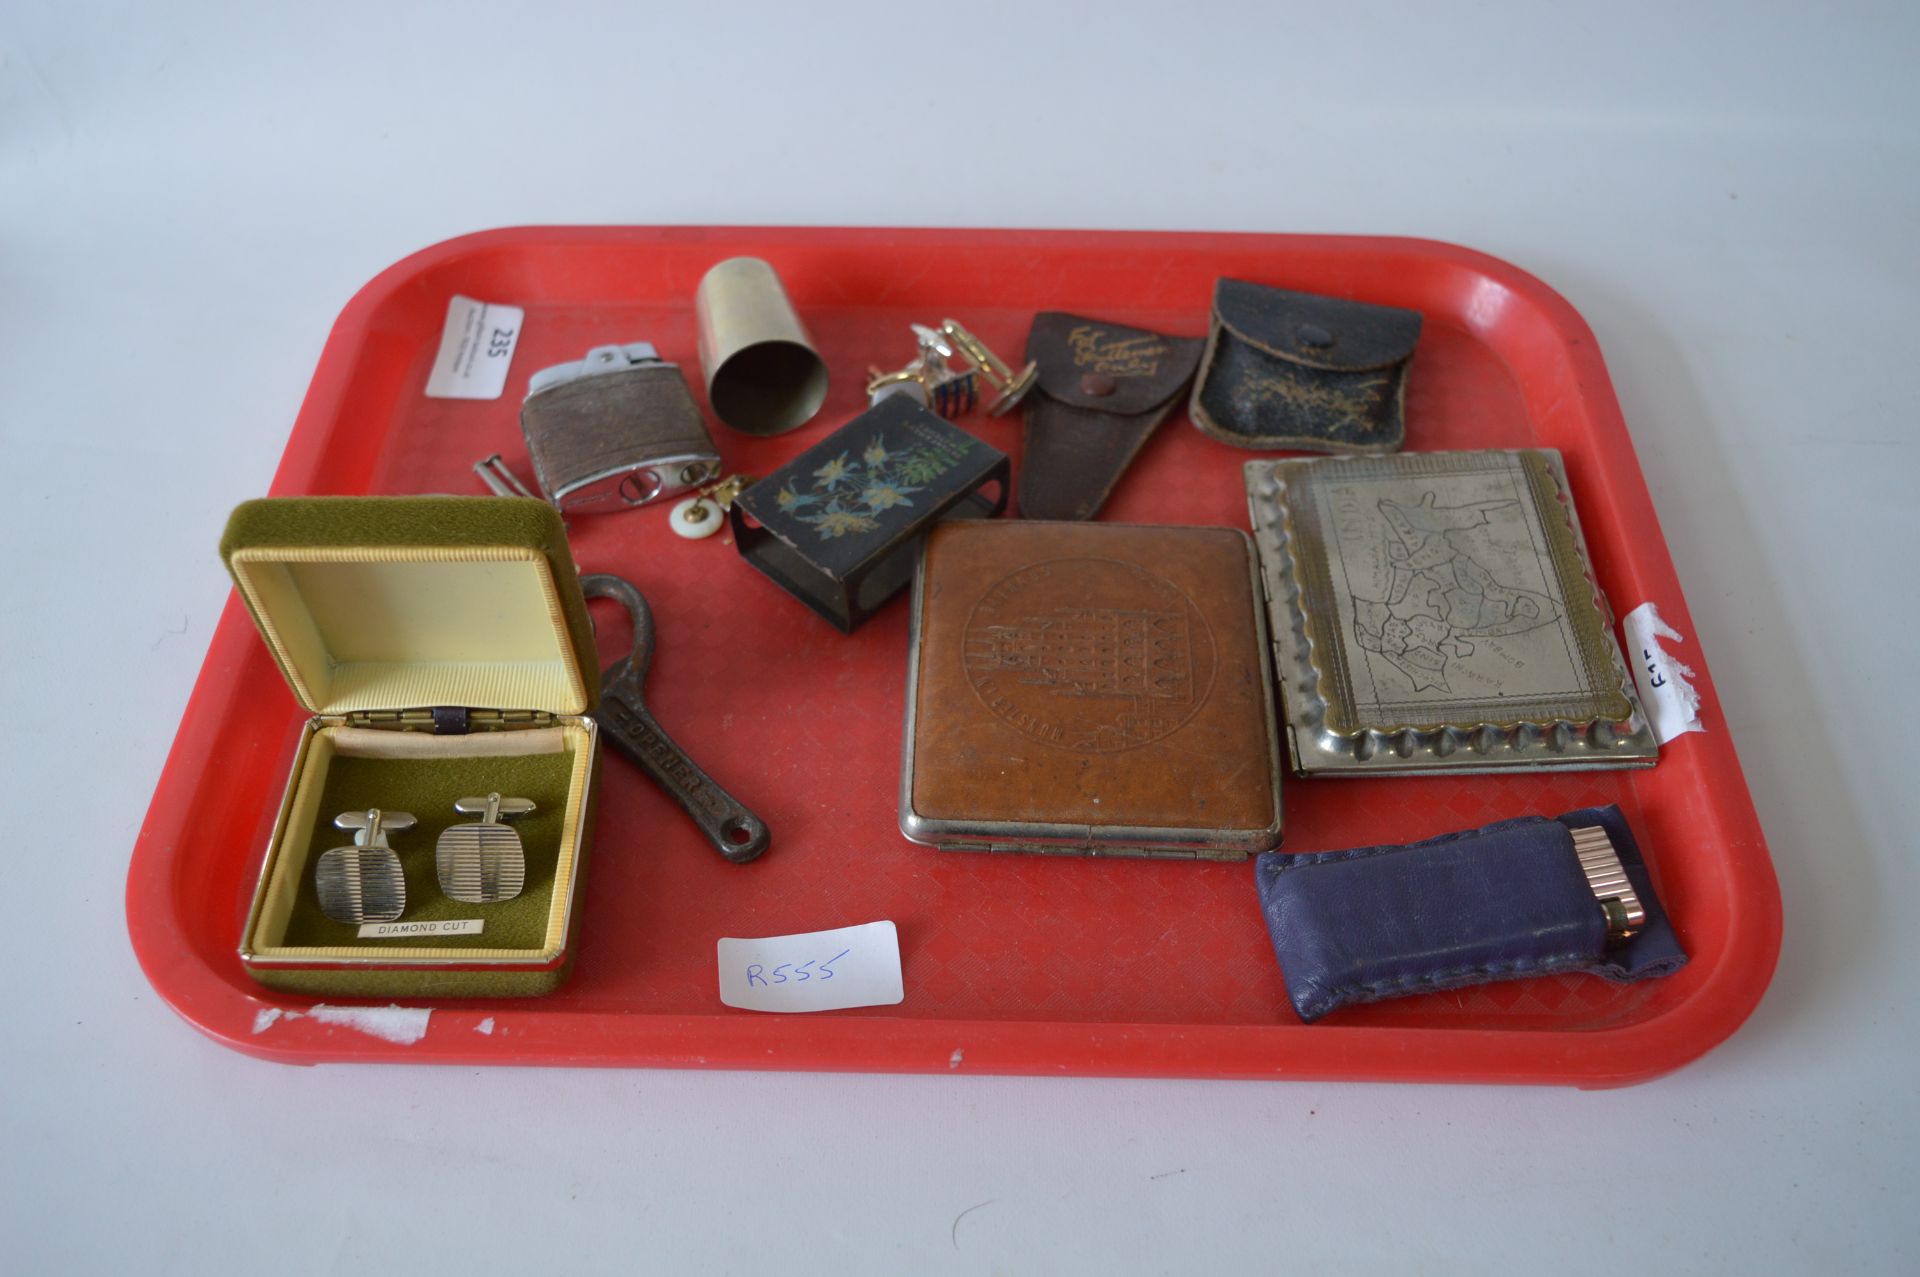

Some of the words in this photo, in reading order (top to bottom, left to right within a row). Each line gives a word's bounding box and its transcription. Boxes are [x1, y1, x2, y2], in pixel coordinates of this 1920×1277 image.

[487, 328, 514, 358] 235
[378, 924, 437, 935] DIAMOND
[443, 921, 470, 932] CUT
[747, 949, 850, 988] R555
